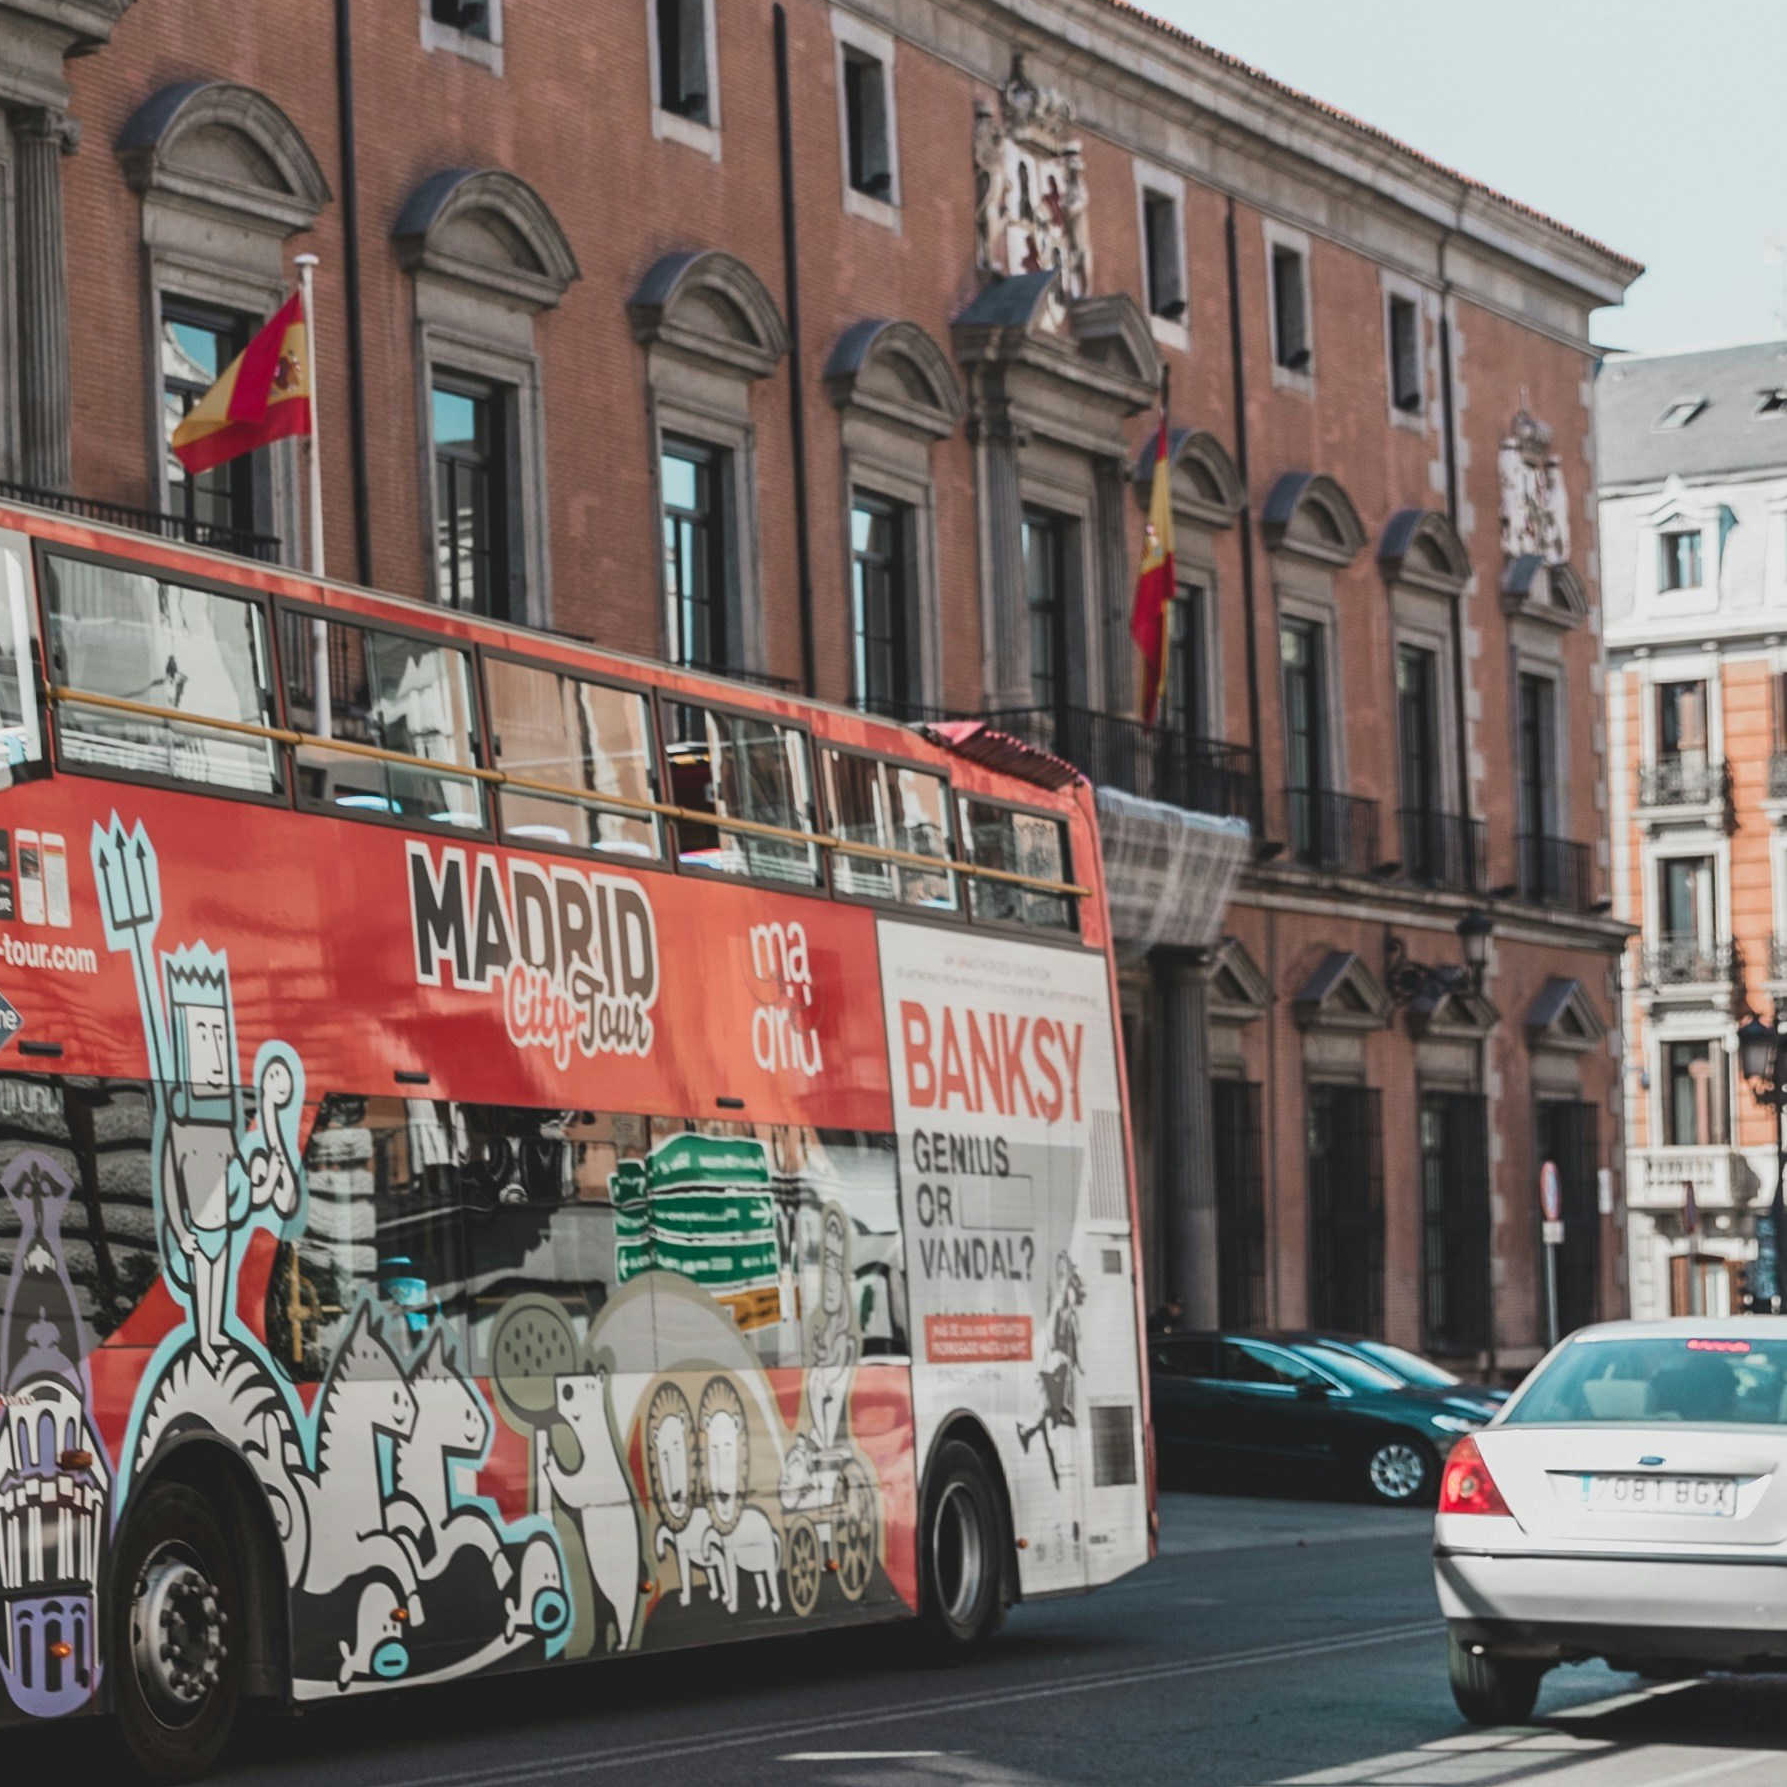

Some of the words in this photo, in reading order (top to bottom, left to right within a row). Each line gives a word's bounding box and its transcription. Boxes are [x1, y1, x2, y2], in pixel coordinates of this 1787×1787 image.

[407, 842, 658, 1004] MADRID
[510, 964, 577, 1067] City
[570, 968, 651, 1055] Tour
[898, 999, 1085, 1124] BANKSY
[912, 1127, 1010, 1178] GENIUS
[915, 1183, 953, 1229] OR
[918, 1235, 1036, 1283] VANDAL?
[1675, 1478, 1727, 1506] BGX
